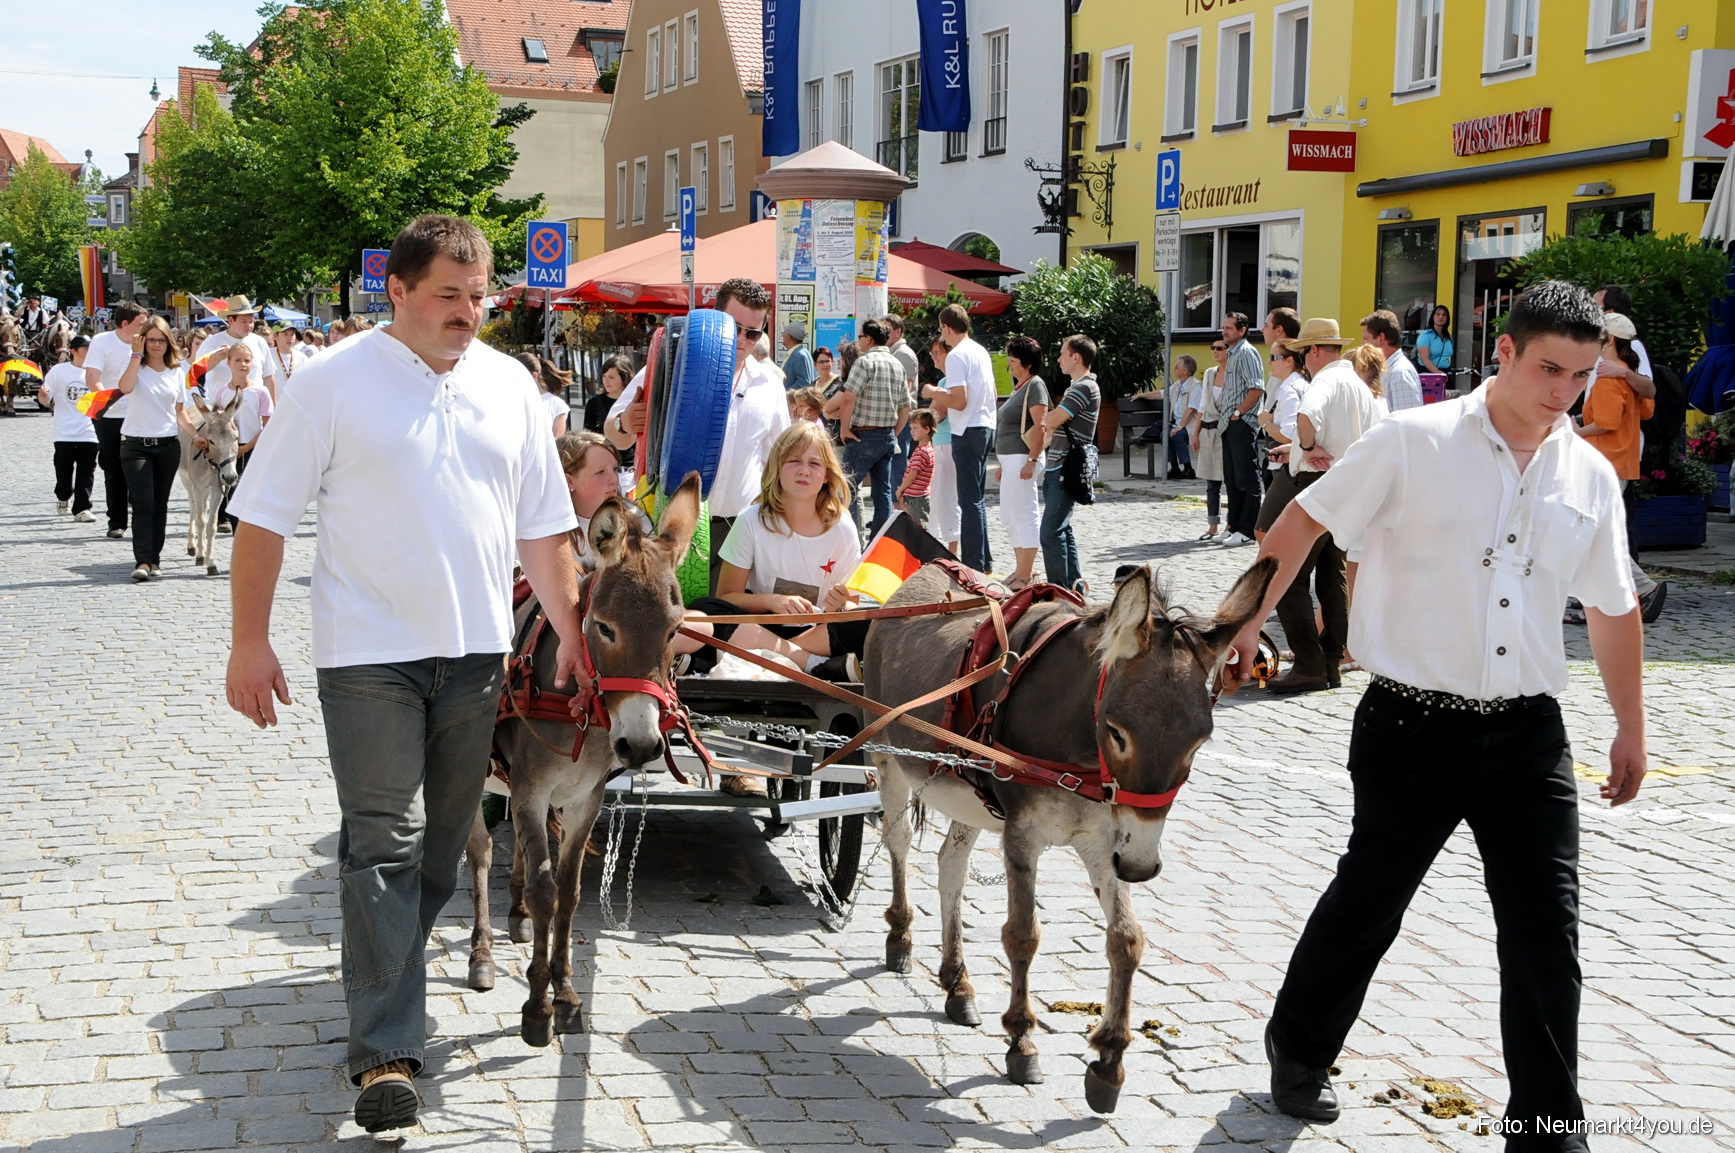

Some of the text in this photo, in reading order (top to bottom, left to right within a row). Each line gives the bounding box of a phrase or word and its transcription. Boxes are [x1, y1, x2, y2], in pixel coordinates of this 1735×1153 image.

[944, 40, 961, 89] K&L
[1451, 107, 1553, 156] WISSMACH
[1291, 143, 1353, 159] WISSMACH
[1160, 158, 1175, 203] P
[683, 194, 693, 230] P
[366, 279, 386, 290] TAX
[531, 267, 563, 283] TAXI
[793, 294, 809, 304] Aug.
